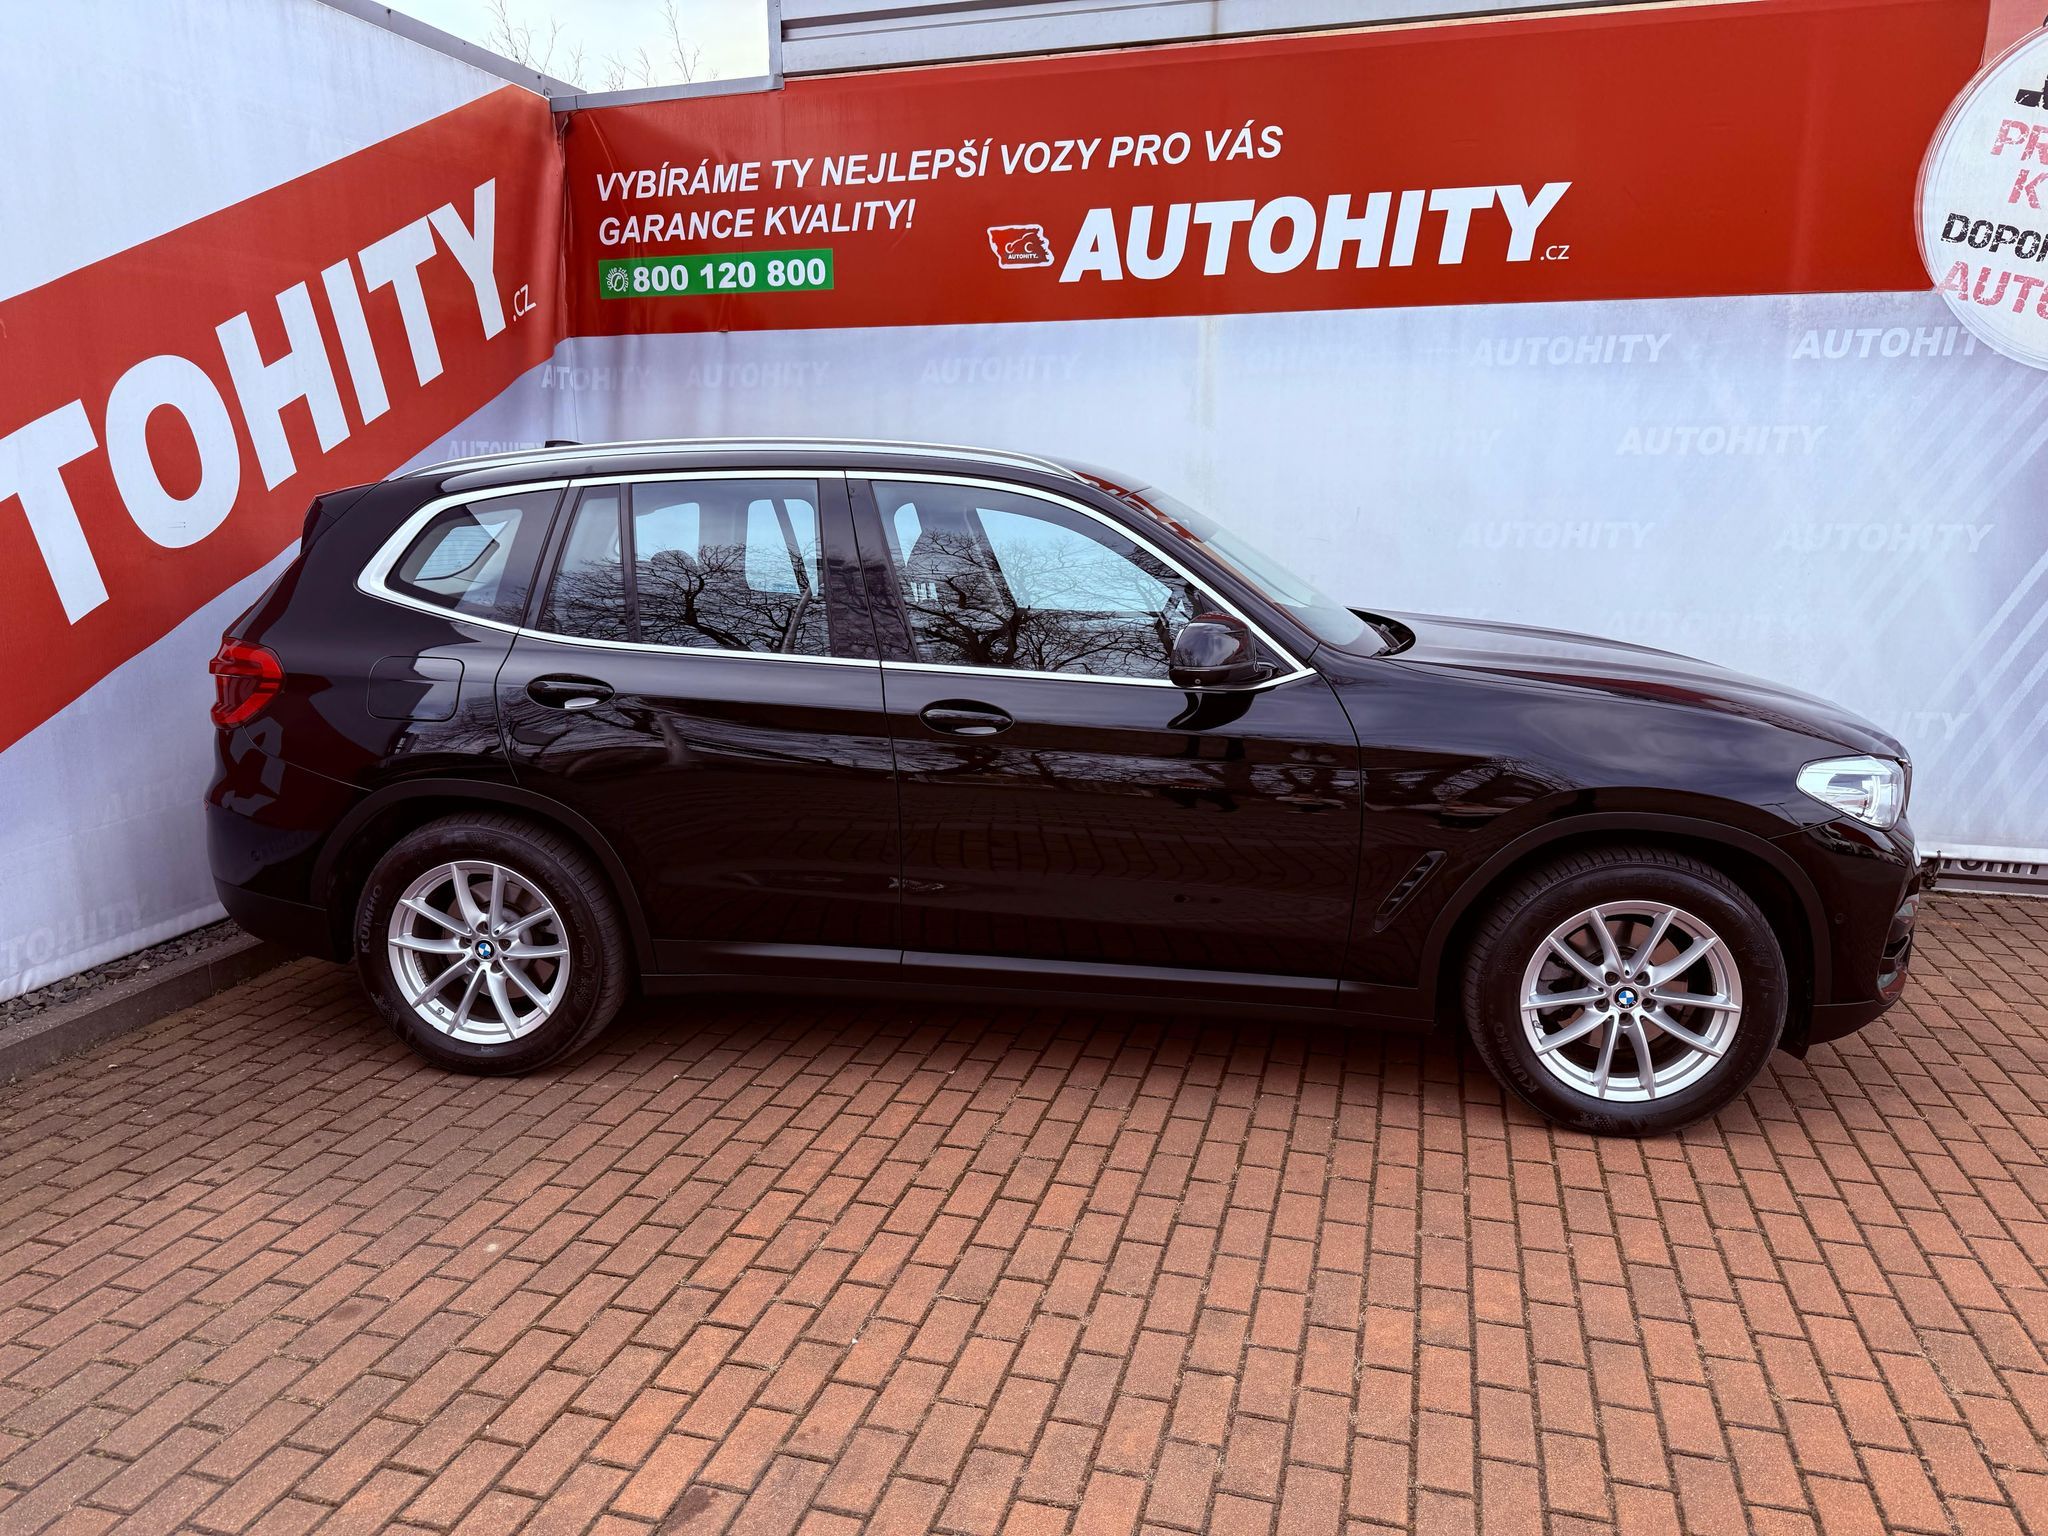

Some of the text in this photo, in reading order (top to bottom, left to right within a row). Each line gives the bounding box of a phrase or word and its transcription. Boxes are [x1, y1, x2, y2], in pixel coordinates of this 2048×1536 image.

[596, 119, 1284, 201] VYBÍRÁME TY NEJLEPŠÍ VOZY PRO VÁS
[598, 198, 917, 246] GARANCE KVALITY!
[1941, 212, 2048, 262] DOPO
[633, 257, 827, 293] 800 120 800
[1470, 333, 1673, 366] AUTOHITY
[1792, 326, 2002, 360] AUTOHIT
[685, 359, 830, 391] AUTOHITY
[920, 352, 1084, 385] AUTOHITY
[1615, 425, 1829, 457] AUTOHITY
[1458, 521, 1656, 551] AUTOHITY
[1773, 522, 1995, 554] AUTOHITY
[360, 884, 384, 954] KUMHO
